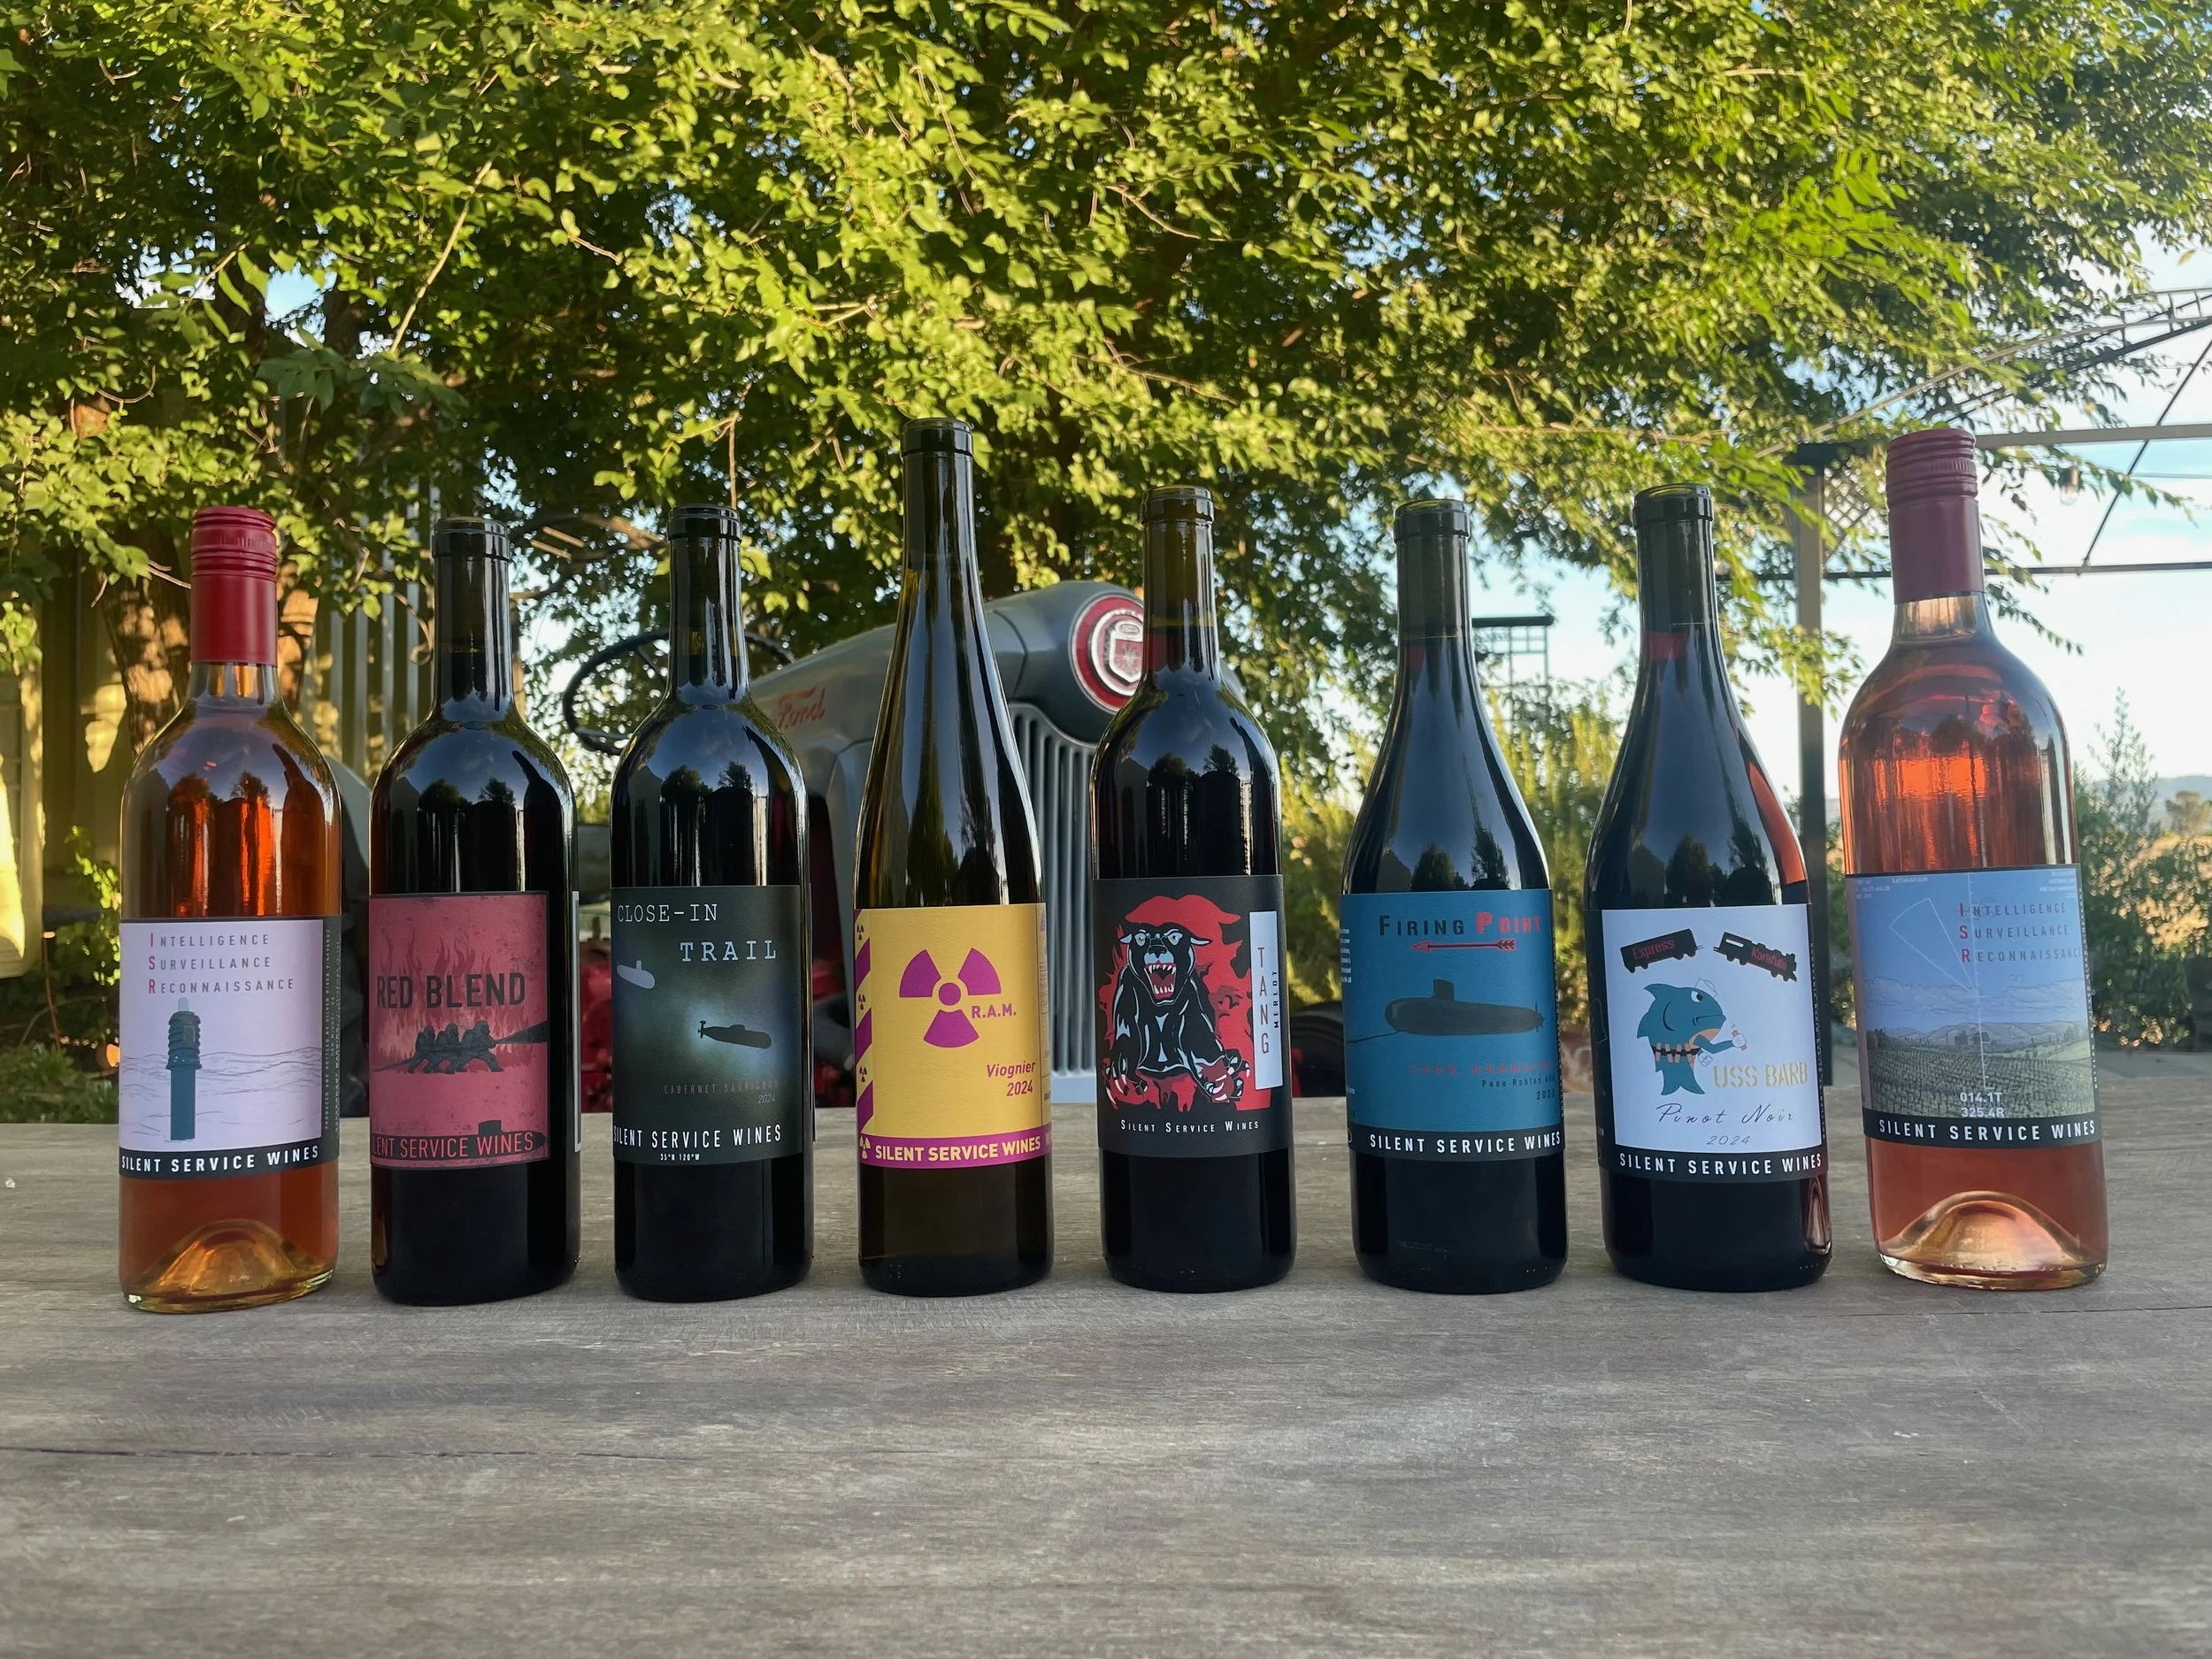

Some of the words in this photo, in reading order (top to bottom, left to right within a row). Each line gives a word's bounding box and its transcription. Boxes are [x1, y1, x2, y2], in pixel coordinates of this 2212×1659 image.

[618, 903, 718, 922] CLOSE-IN
[1958, 902, 2066, 918] INTELLIGENCE
[1380, 914, 1464, 936] FIRING
[1475, 911, 1540, 934] POINT
[1959, 925, 2068, 939] SURVEILLANCE
[150, 933, 269, 947] INTELLIGENCE
[1632, 939, 1675, 960] Express
[680, 940, 776, 962] TRAIL
[149, 956, 271, 971] SURVEILLANCE
[149, 978, 294, 994] RECONNAISSANCE
[376, 975, 413, 1009] RED
[426, 972, 526, 1009] BLEND
[1257, 947, 1269, 1054] TANG
[971, 1003, 1017, 1019] R.A.M.
[987, 1062, 1036, 1079] Viognier
[1713, 1065, 1758, 1088] USS
[1765, 1061, 1808, 1087] BARB
[664, 1084, 716, 1094] CABERNET
[1006, 1080, 1033, 1097] 2024
[1960, 1092, 2003, 1102] 014.1T
[758, 1094, 776, 1104] 2024
[1656, 1102, 1727, 1123] Pinot
[1741, 1103, 1794, 1124] Noir
[1961, 1107, 2005, 1118] 325.4R
[1120, 1119, 1155, 1132] SILENT
[1165, 1122, 1215, 1133] SERVICE
[1225, 1121, 1259, 1131] WINES
[1879, 1119, 1936, 1139] SILENT
[1949, 1125, 2040, 1141] SERVICE
[2051, 1119, 2095, 1139] WINES
[400, 1138, 468, 1158] SERVICE
[477, 1132, 534, 1156] WINES
[651, 1130, 721, 1148] SERVICE
[733, 1124, 782, 1146] WINES
[1370, 1134, 1425, 1153] SILENT
[1437, 1137, 1515, 1154] SERVICE
[1524, 1131, 1561, 1151] WINES
[1706, 1135, 1751, 1145] 2024
[875, 1144, 925, 1161] SILENT
[928, 1143, 998, 1161] SERVICE
[1002, 1136, 1041, 1156] WINES
[121, 1155, 161, 1173] SILENT
[171, 1154, 255, 1173] SERVICE
[267, 1145, 319, 1166] WINES
[1620, 1153, 1676, 1173] SILENT
[1688, 1159, 1772, 1175] SERVICE
[1782, 1153, 1821, 1173] WINES
